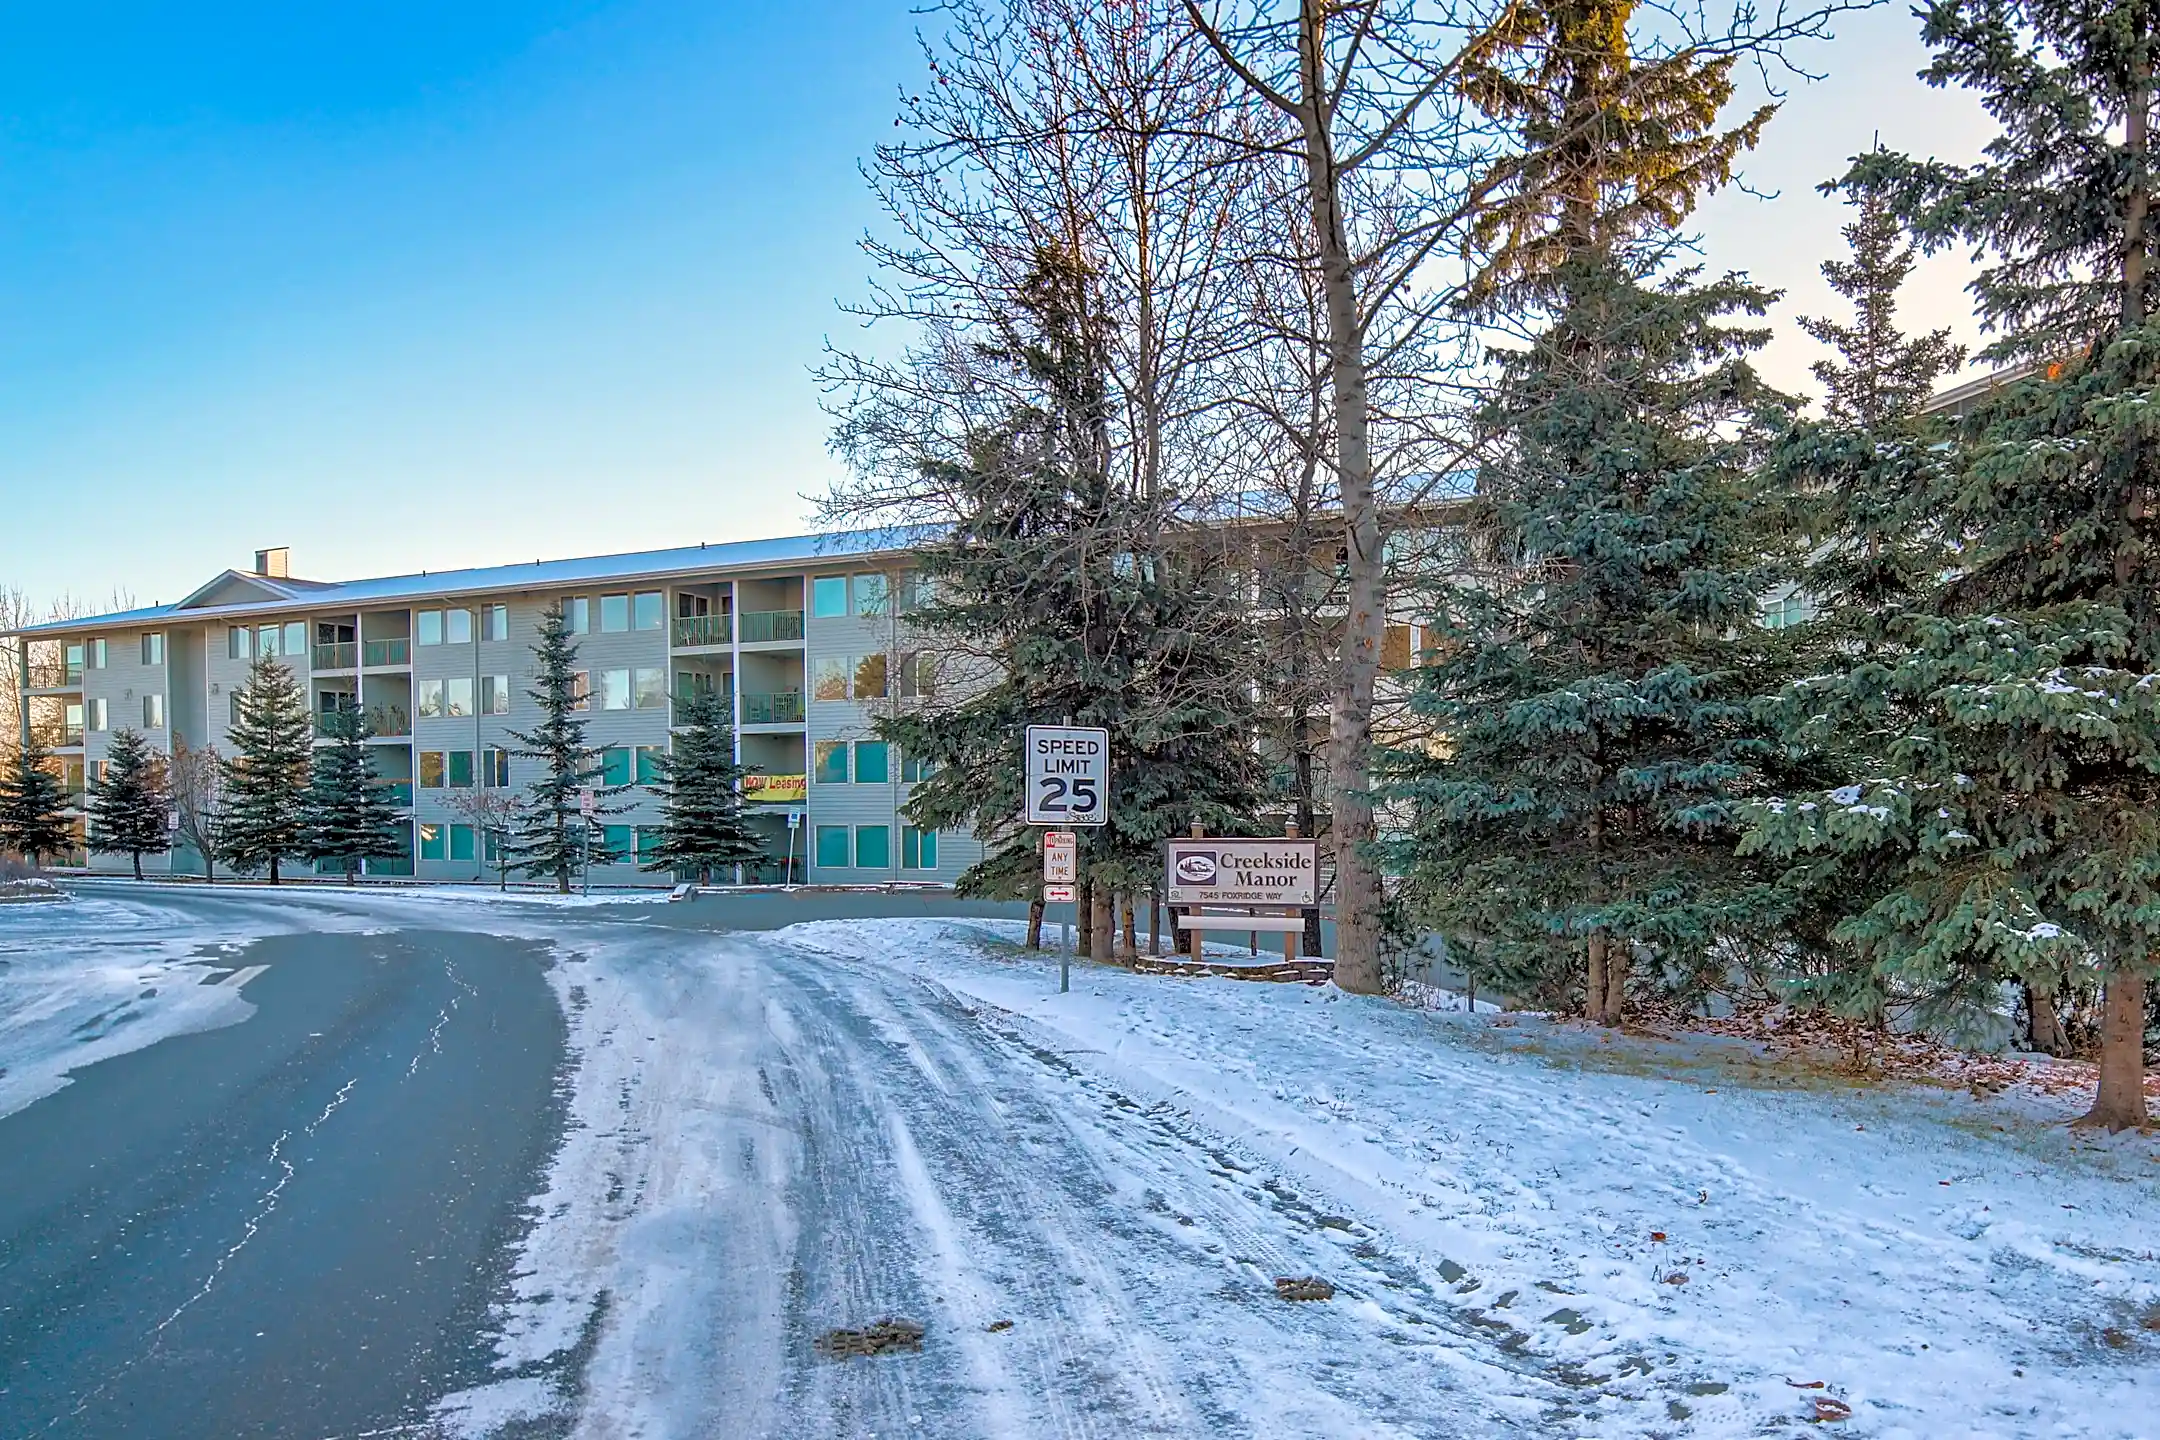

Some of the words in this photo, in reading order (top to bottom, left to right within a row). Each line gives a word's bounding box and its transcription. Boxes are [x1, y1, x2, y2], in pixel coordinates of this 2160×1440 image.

[1037, 740, 1099, 755] SPEED
[1045, 759, 1091, 774] LIMIT
[769, 777, 806, 790] Leasing
[1039, 777, 1097, 812] 25
[1046, 835, 1055, 846] NO
[1051, 852, 1069, 862] ANY
[1220, 852, 1312, 869] Creekside
[1051, 866, 1069, 875] TIME
[1235, 871, 1297, 887] Manor
[1199, 891, 1219, 899] 7545
[1222, 892, 1262, 900] FOXRIDGE
[1265, 892, 1283, 900] WAY
